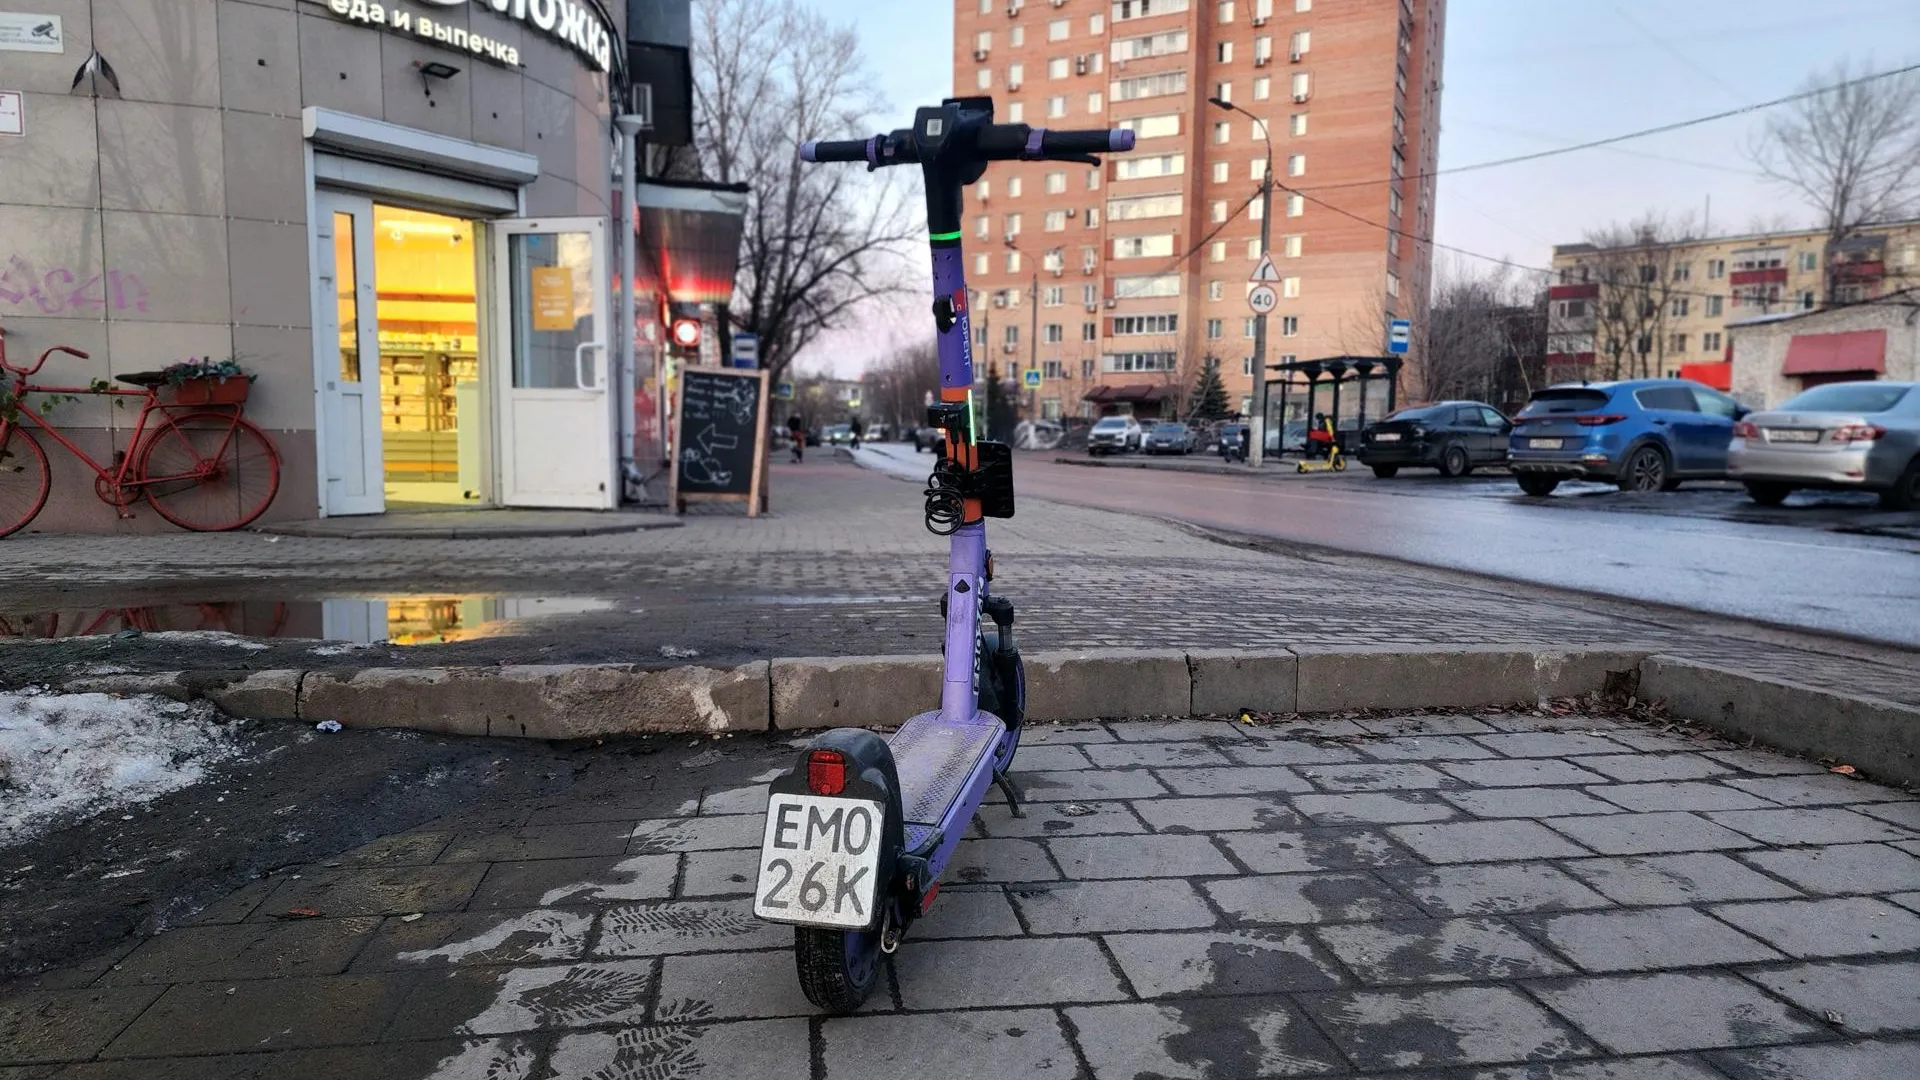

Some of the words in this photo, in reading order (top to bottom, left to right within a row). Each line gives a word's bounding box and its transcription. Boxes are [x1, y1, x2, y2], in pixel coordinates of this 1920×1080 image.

[330, 0, 385, 23] еда
[392, 10, 410, 31] и
[417, 17, 519, 66] выпечка
[1253, 294, 1272, 307] 40
[762, 859, 869, 915] 26K
